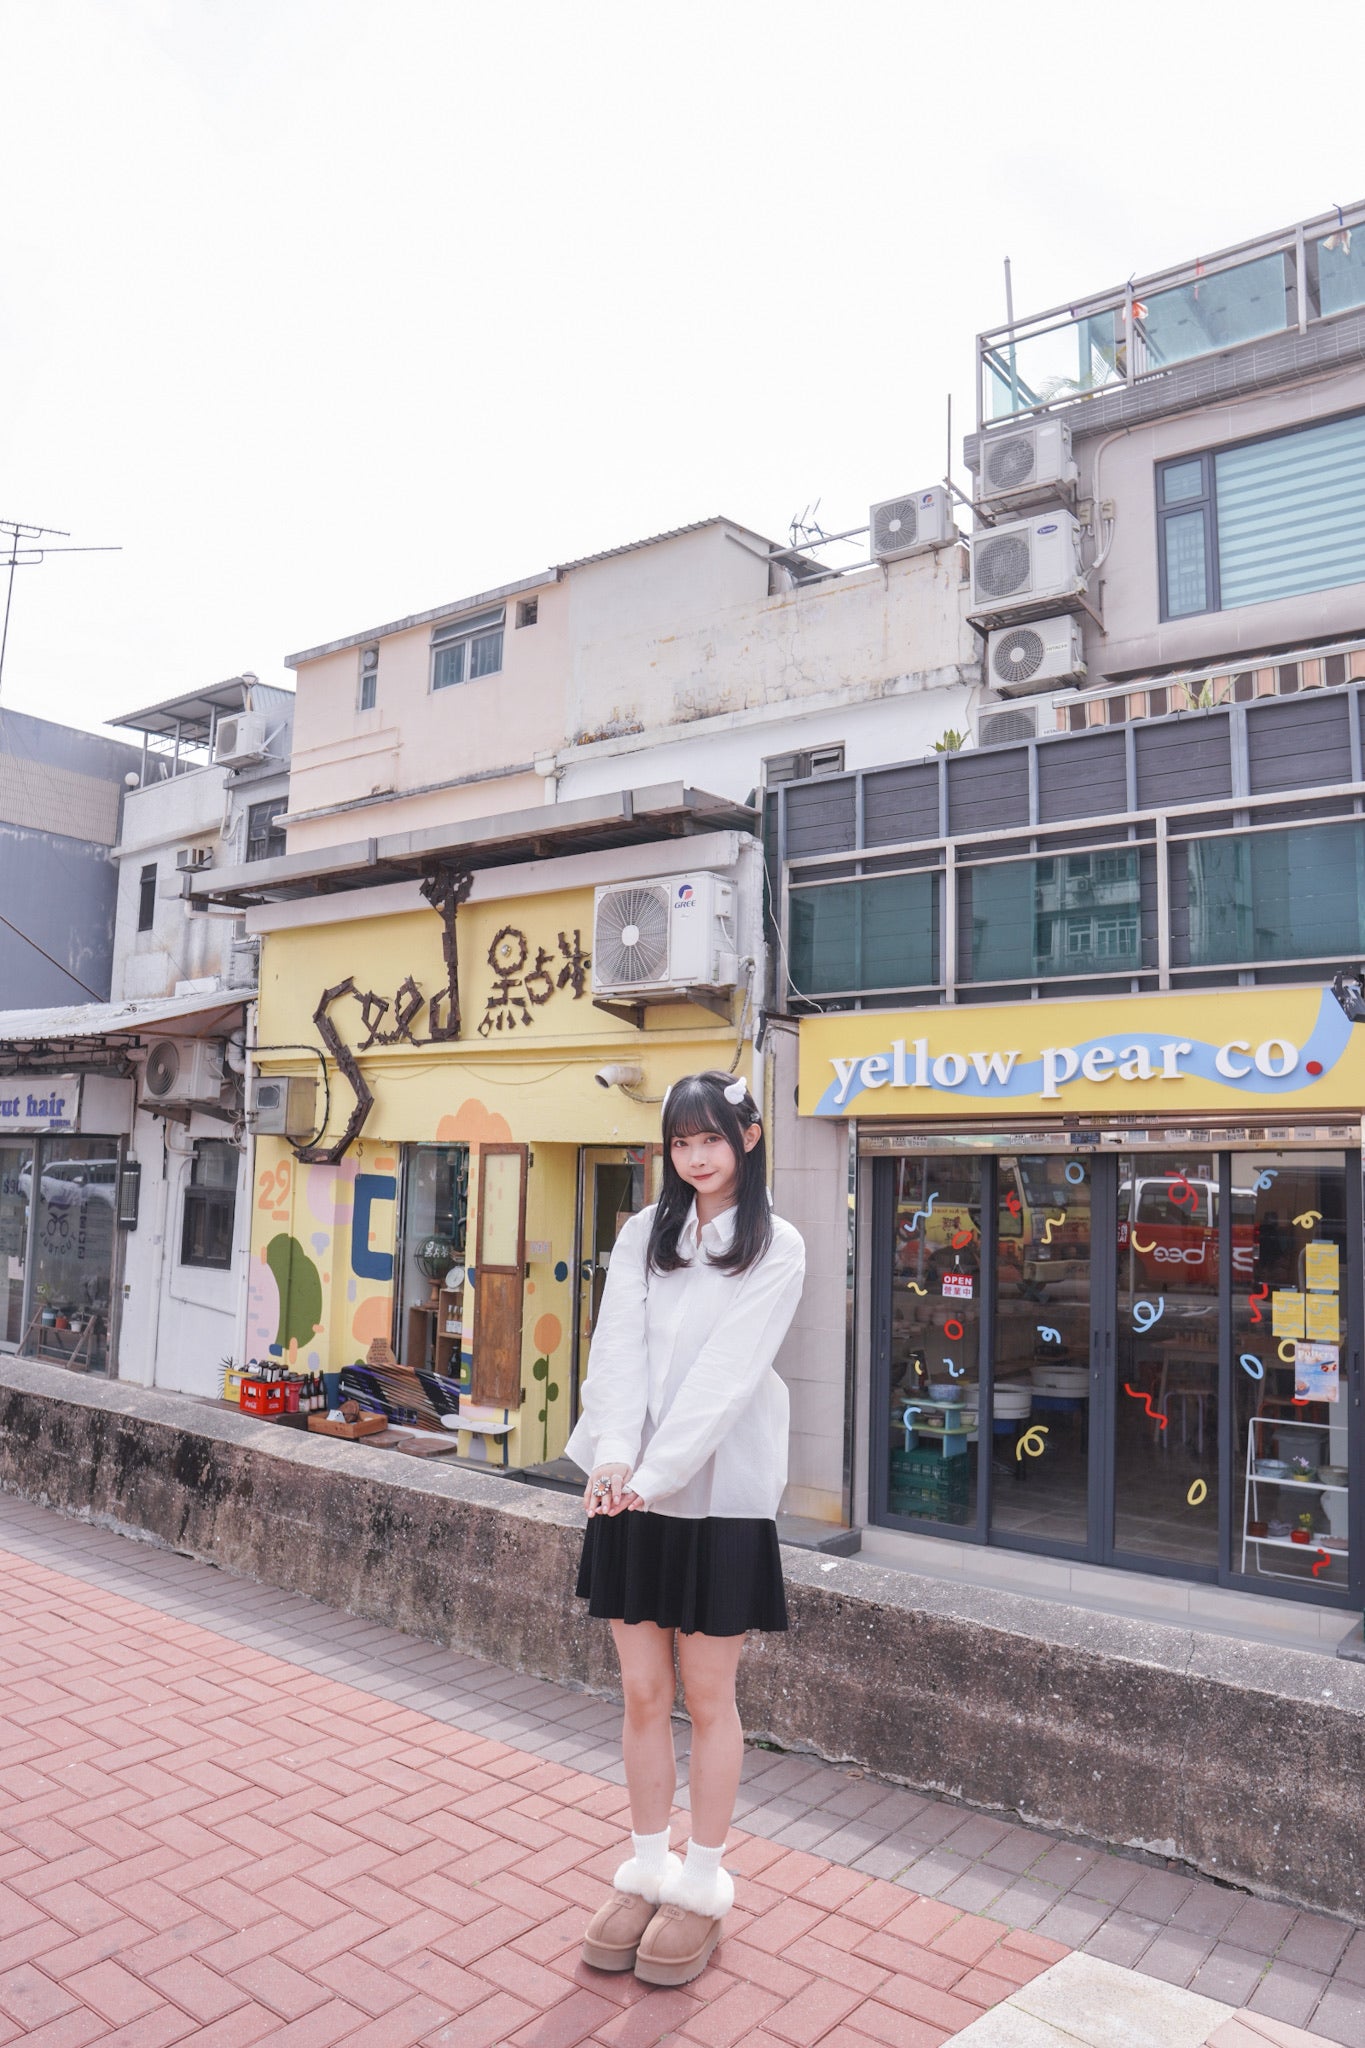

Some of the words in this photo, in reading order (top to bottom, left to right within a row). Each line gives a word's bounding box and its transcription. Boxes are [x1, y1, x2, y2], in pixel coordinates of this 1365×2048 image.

[674, 900, 696, 909] GREE
[829, 1037, 1022, 1104] yellow
[1040, 1041, 1193, 1099] pear
[1215, 1039, 1323, 1079] co.
[26, 1092, 65, 1117] hair
[258, 1160, 291, 1210] 29
[943, 1275, 973, 1286] OPEN
